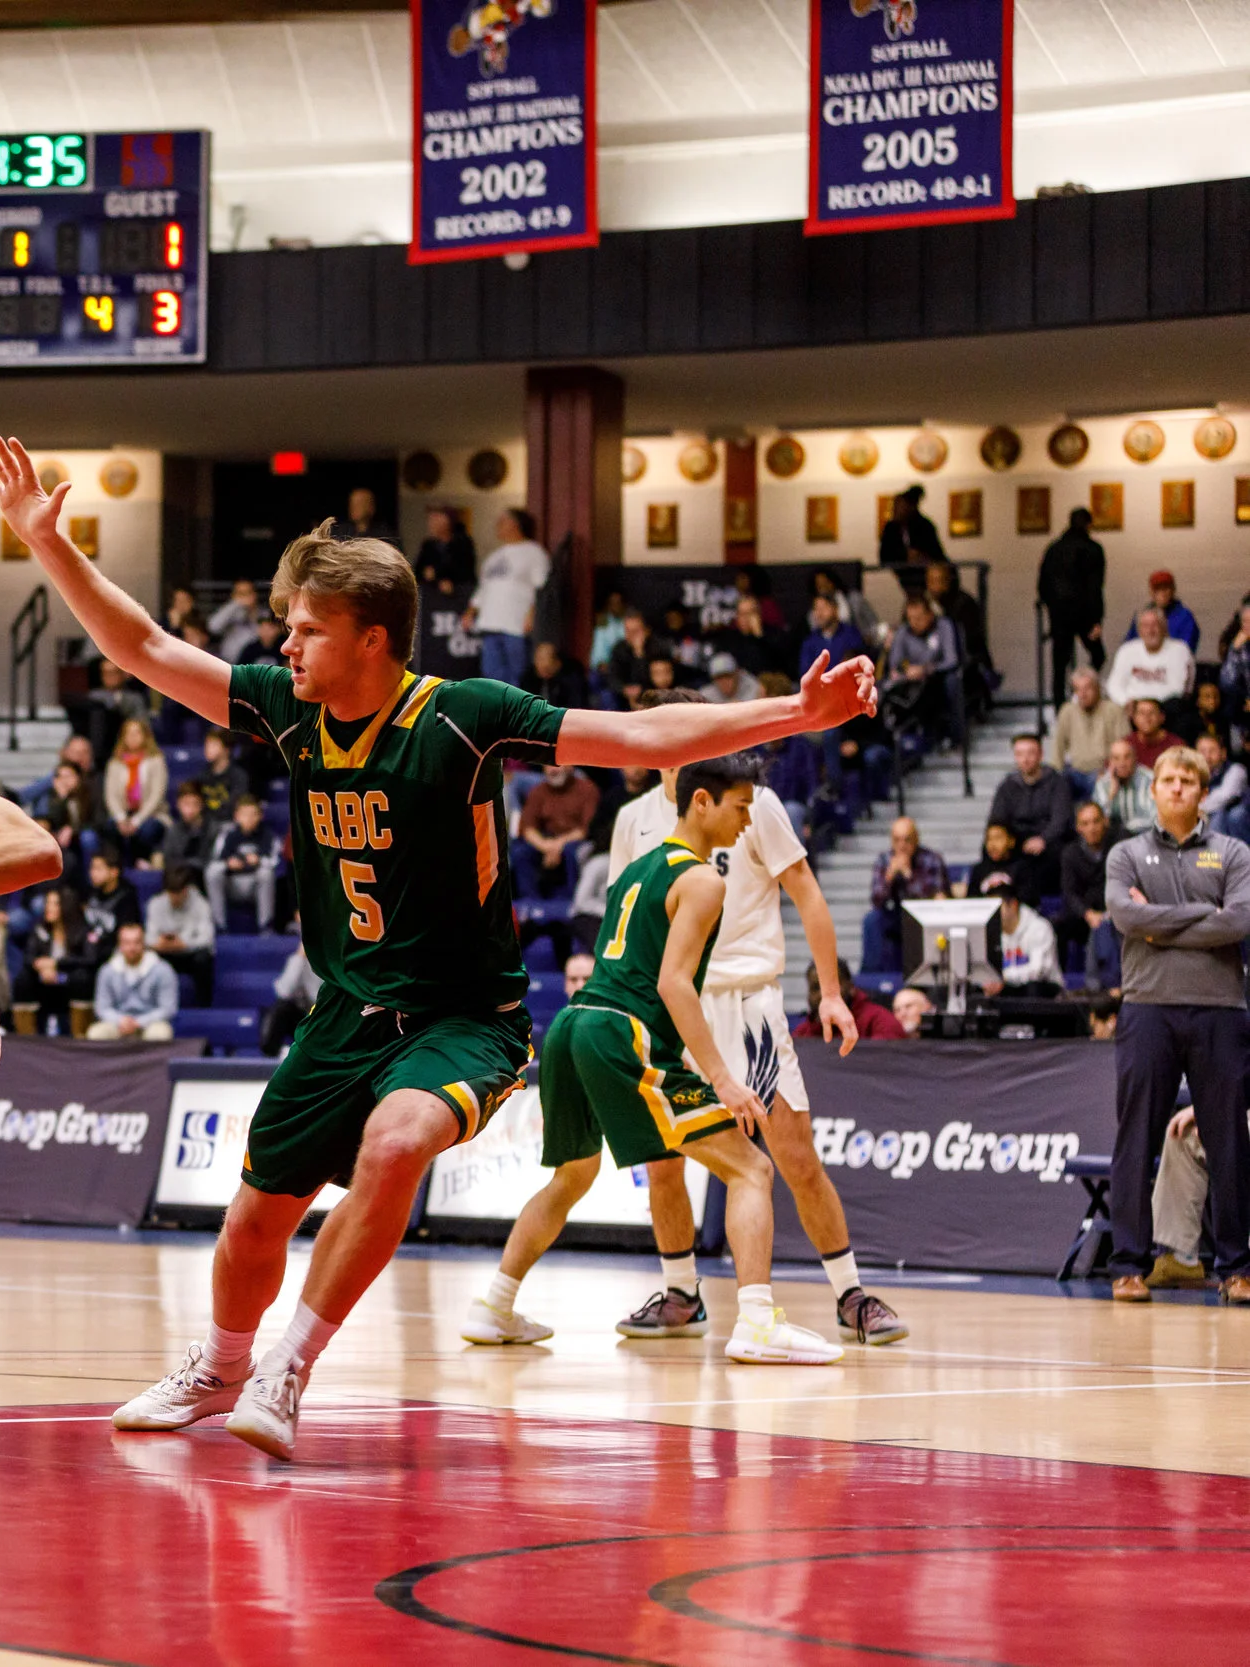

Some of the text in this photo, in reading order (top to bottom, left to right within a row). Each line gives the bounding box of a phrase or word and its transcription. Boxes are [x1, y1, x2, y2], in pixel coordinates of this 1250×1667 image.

[924, 59, 998, 84] NATIONAL
[823, 82, 998, 126] CHAMPIONS
[423, 117, 583, 161] CHAMPIONS
[862, 125, 958, 172] 2005
[104, 190, 179, 217] GUEST
[459, 159, 547, 205] 2002
[827, 178, 927, 210] RECORD:
[164, 221, 183, 270] 1
[434, 209, 526, 240] RECORD:
[13, 231, 30, 267] 1
[84, 296, 114, 332] 4
[152, 290, 182, 335] 3
[308, 789, 393, 850] RBC
[339, 858, 385, 943] 5
[602, 882, 642, 960] 1
